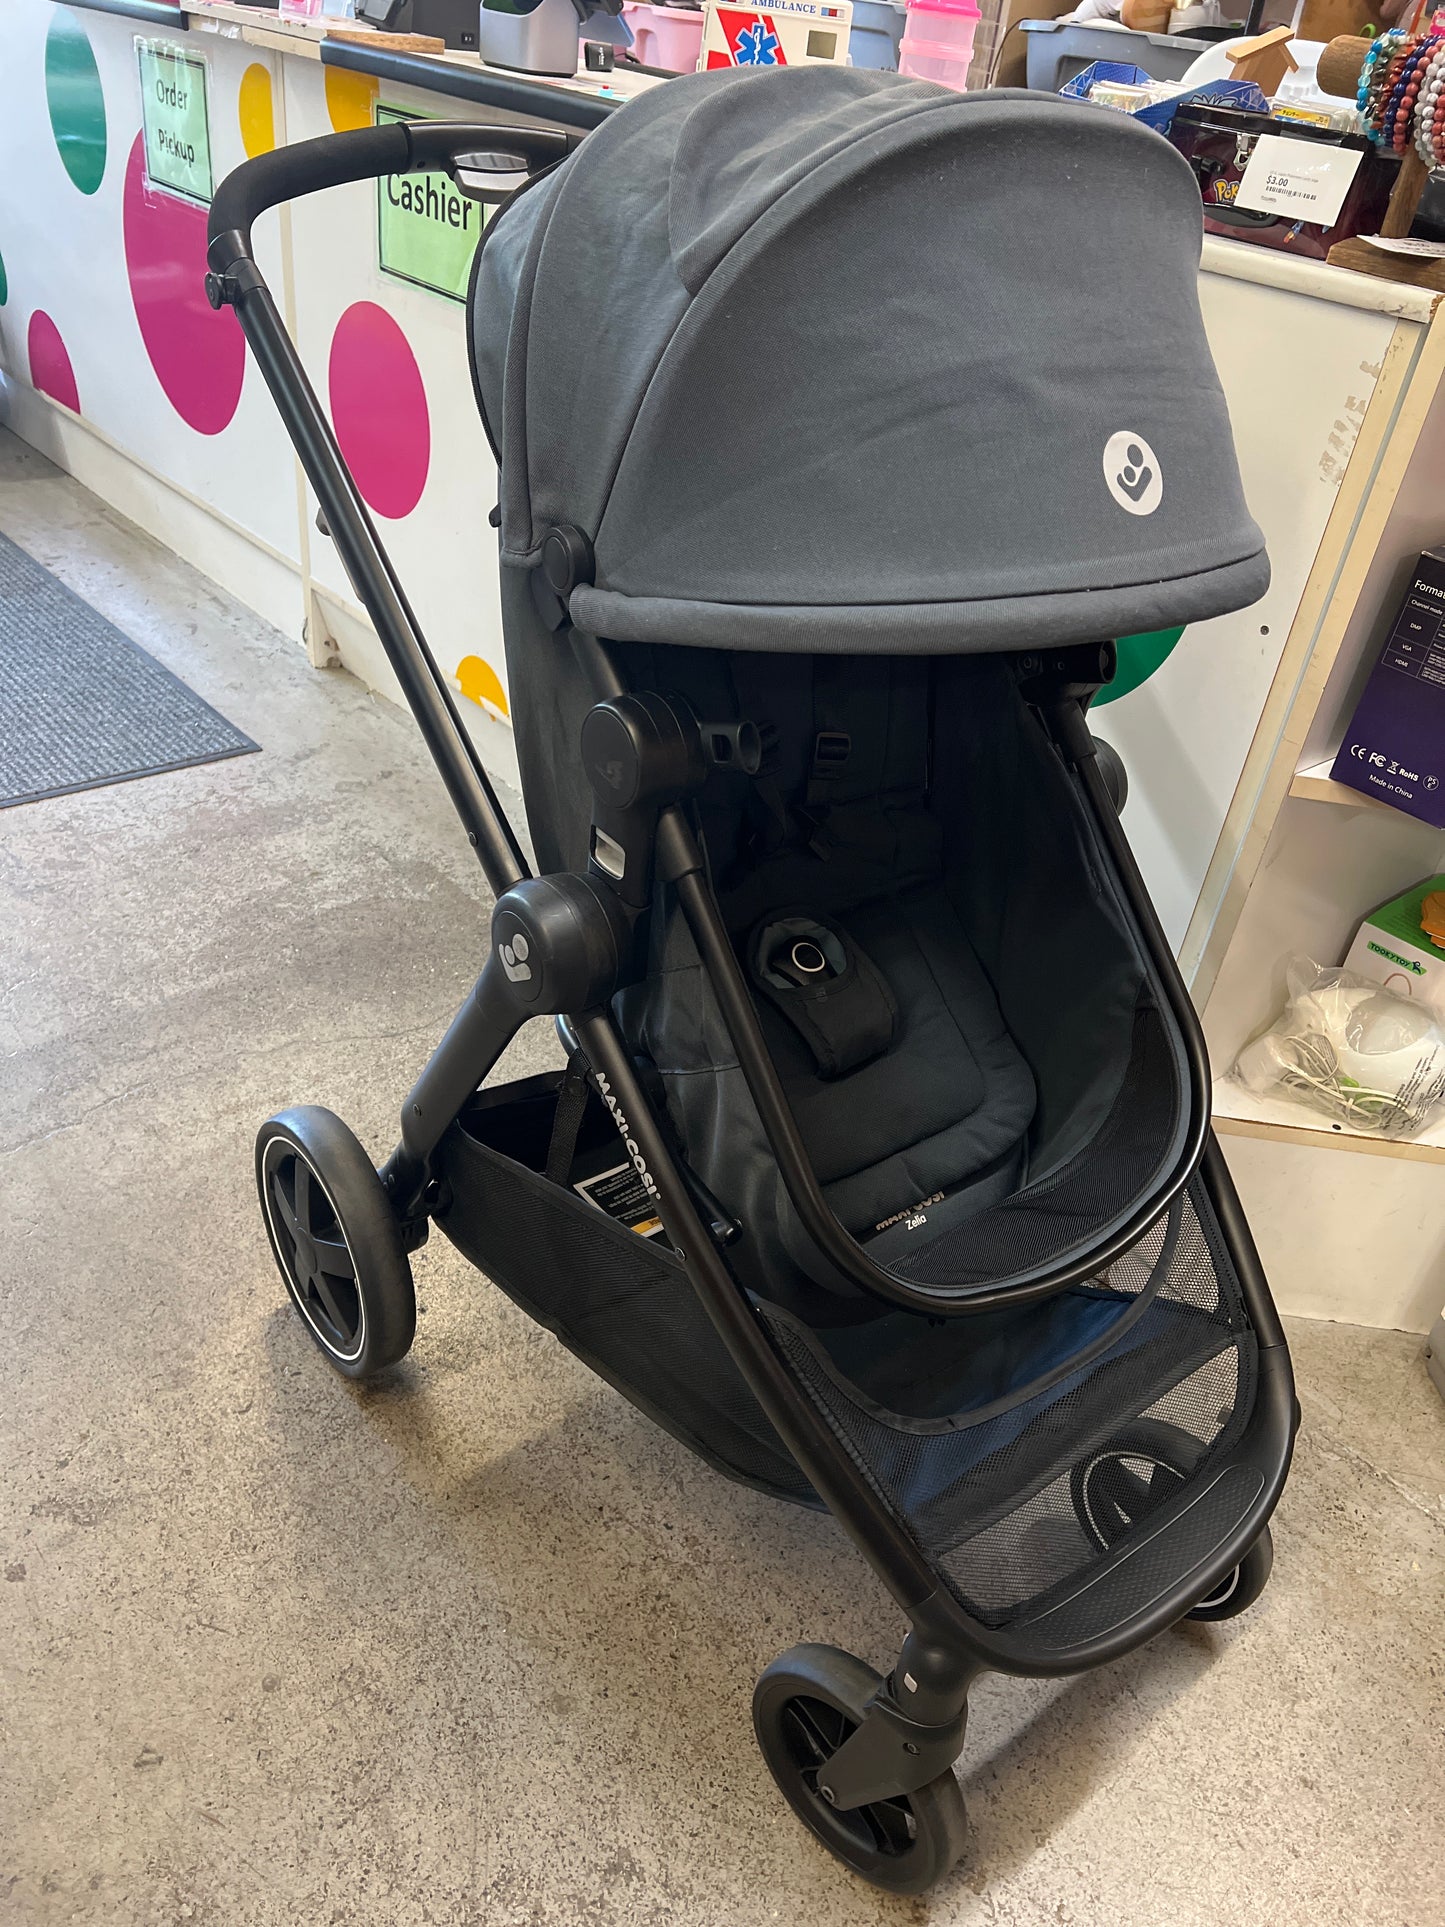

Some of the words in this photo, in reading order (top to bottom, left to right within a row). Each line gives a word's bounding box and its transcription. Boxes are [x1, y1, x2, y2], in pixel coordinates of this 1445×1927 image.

[751, 0, 817, 14] AMBULANCE
[156, 79, 187, 110] Order
[158, 128, 195, 168] Pickup
[1266, 175, 1289, 187] $3.00
[387, 173, 472, 230] Cashier
[1402, 643, 1412, 652] VGA
[1350, 744, 1367, 760] CE
[1398, 768, 1419, 782] RoHS
[1369, 774, 1387, 788] Made
[1387, 782, 1394, 791] in
[1394, 786, 1413, 799] China
[905, 1214, 928, 1231] Zelia
